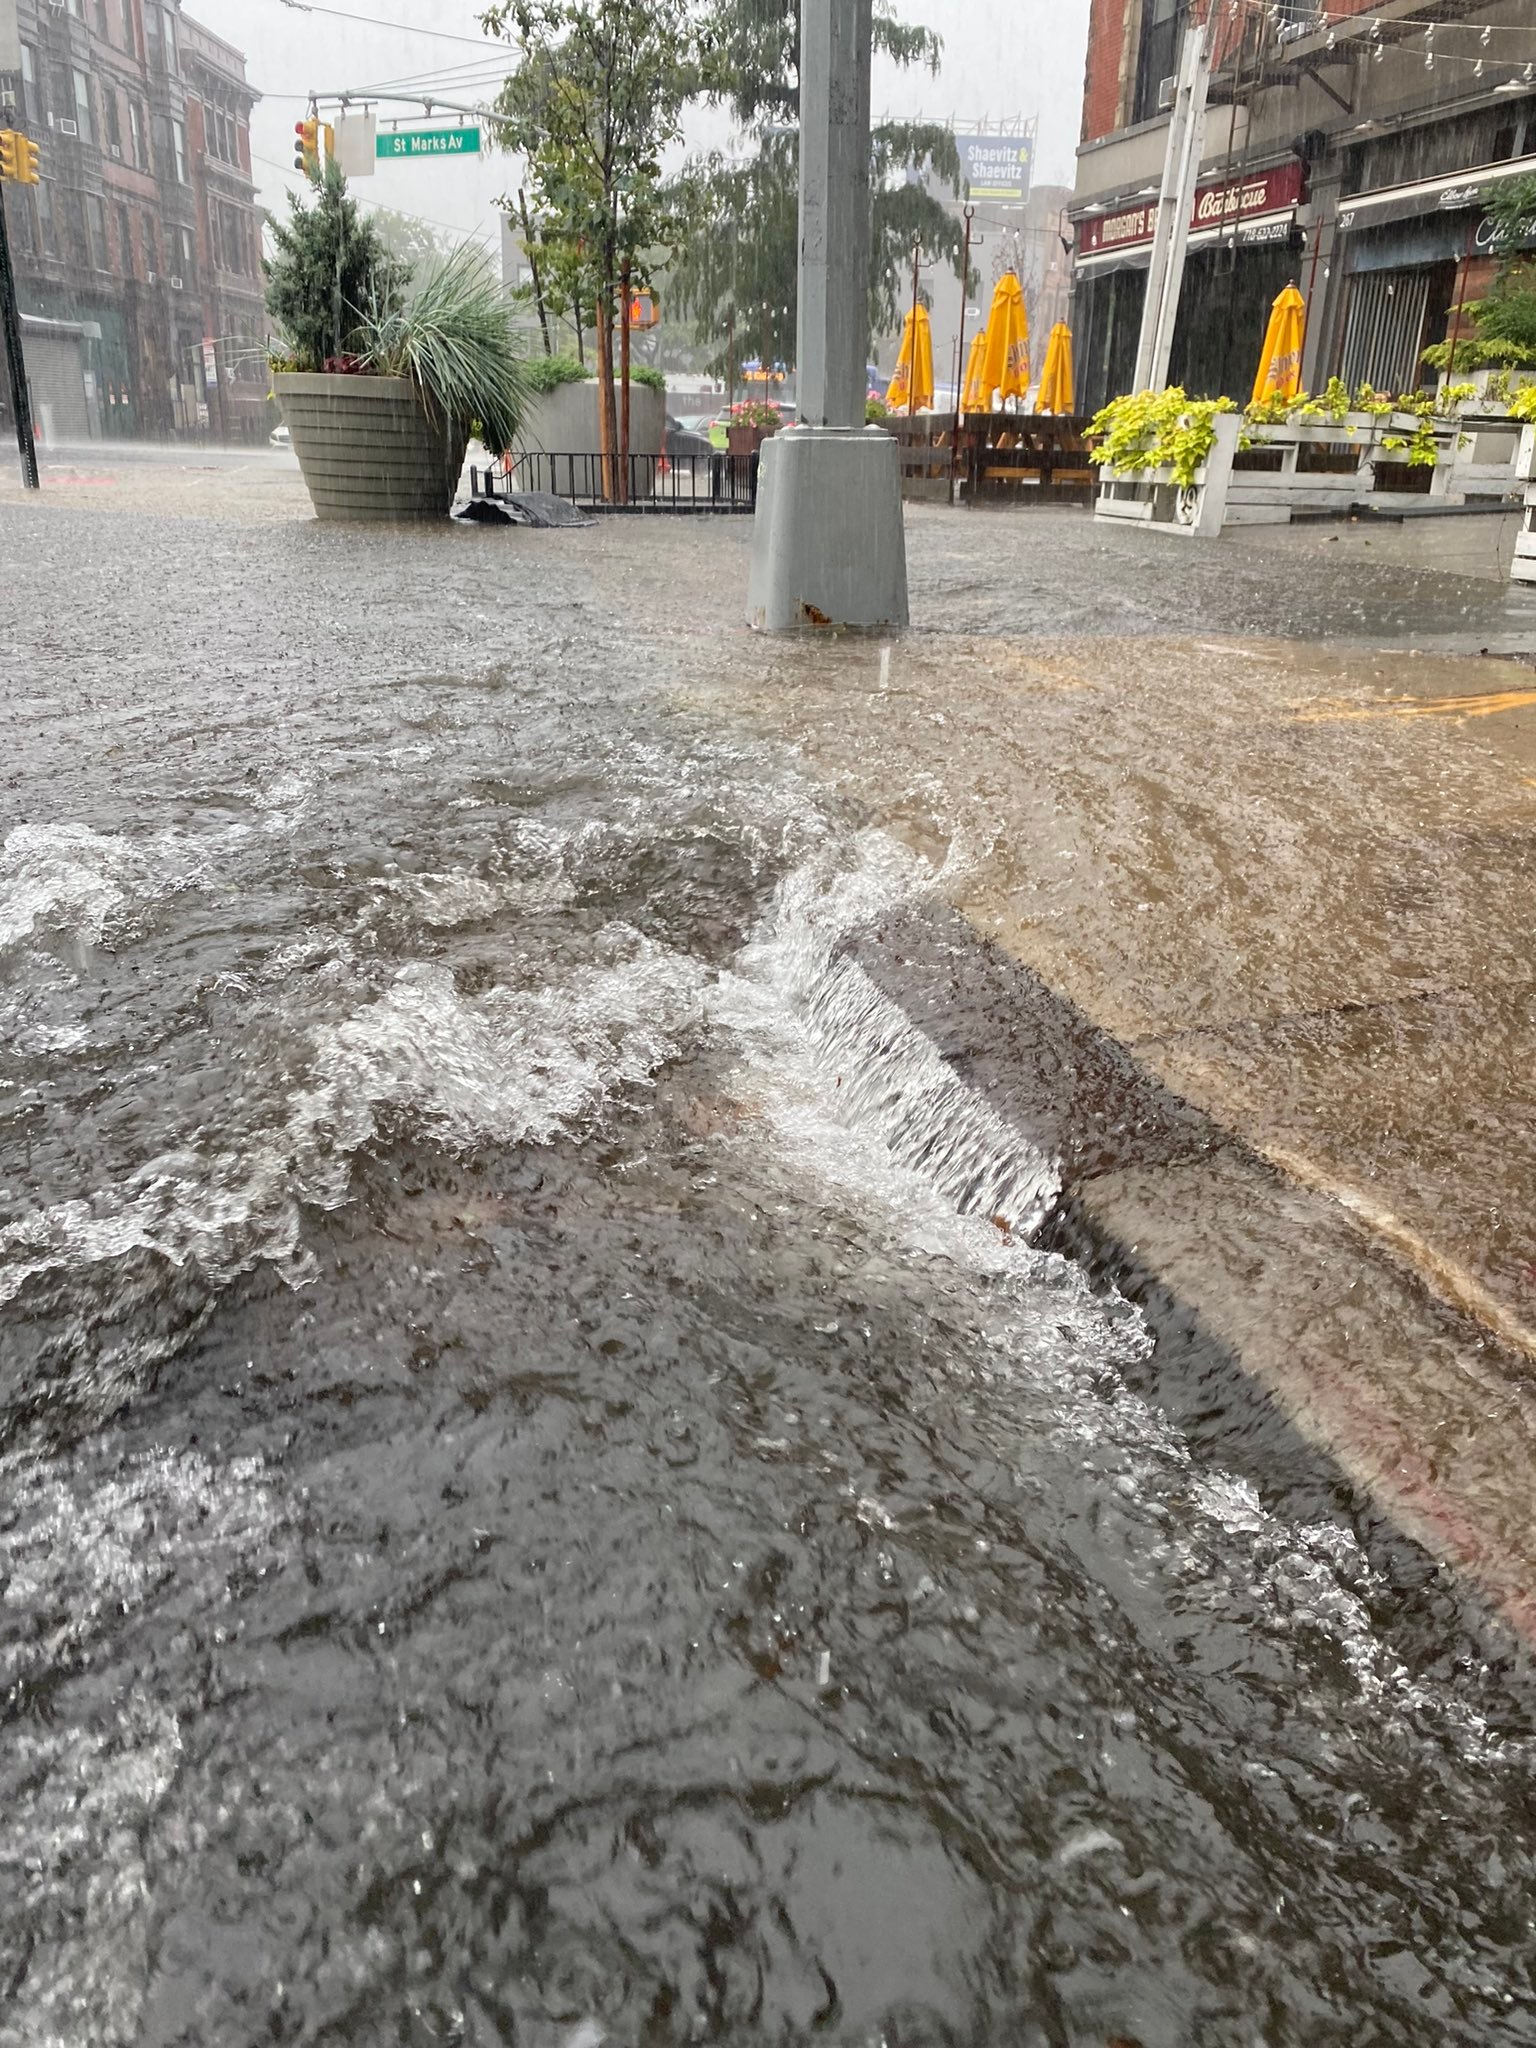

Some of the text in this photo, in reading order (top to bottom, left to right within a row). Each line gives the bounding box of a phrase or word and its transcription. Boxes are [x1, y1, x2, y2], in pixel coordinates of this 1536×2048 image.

[394, 134, 463, 152] St Marks Av
[967, 145, 1017, 162] Shaevitz
[972, 162, 1022, 179] Shaevitz
[1198, 182, 1268, 219] Barbcue
[1339, 212, 1355, 227] 267
